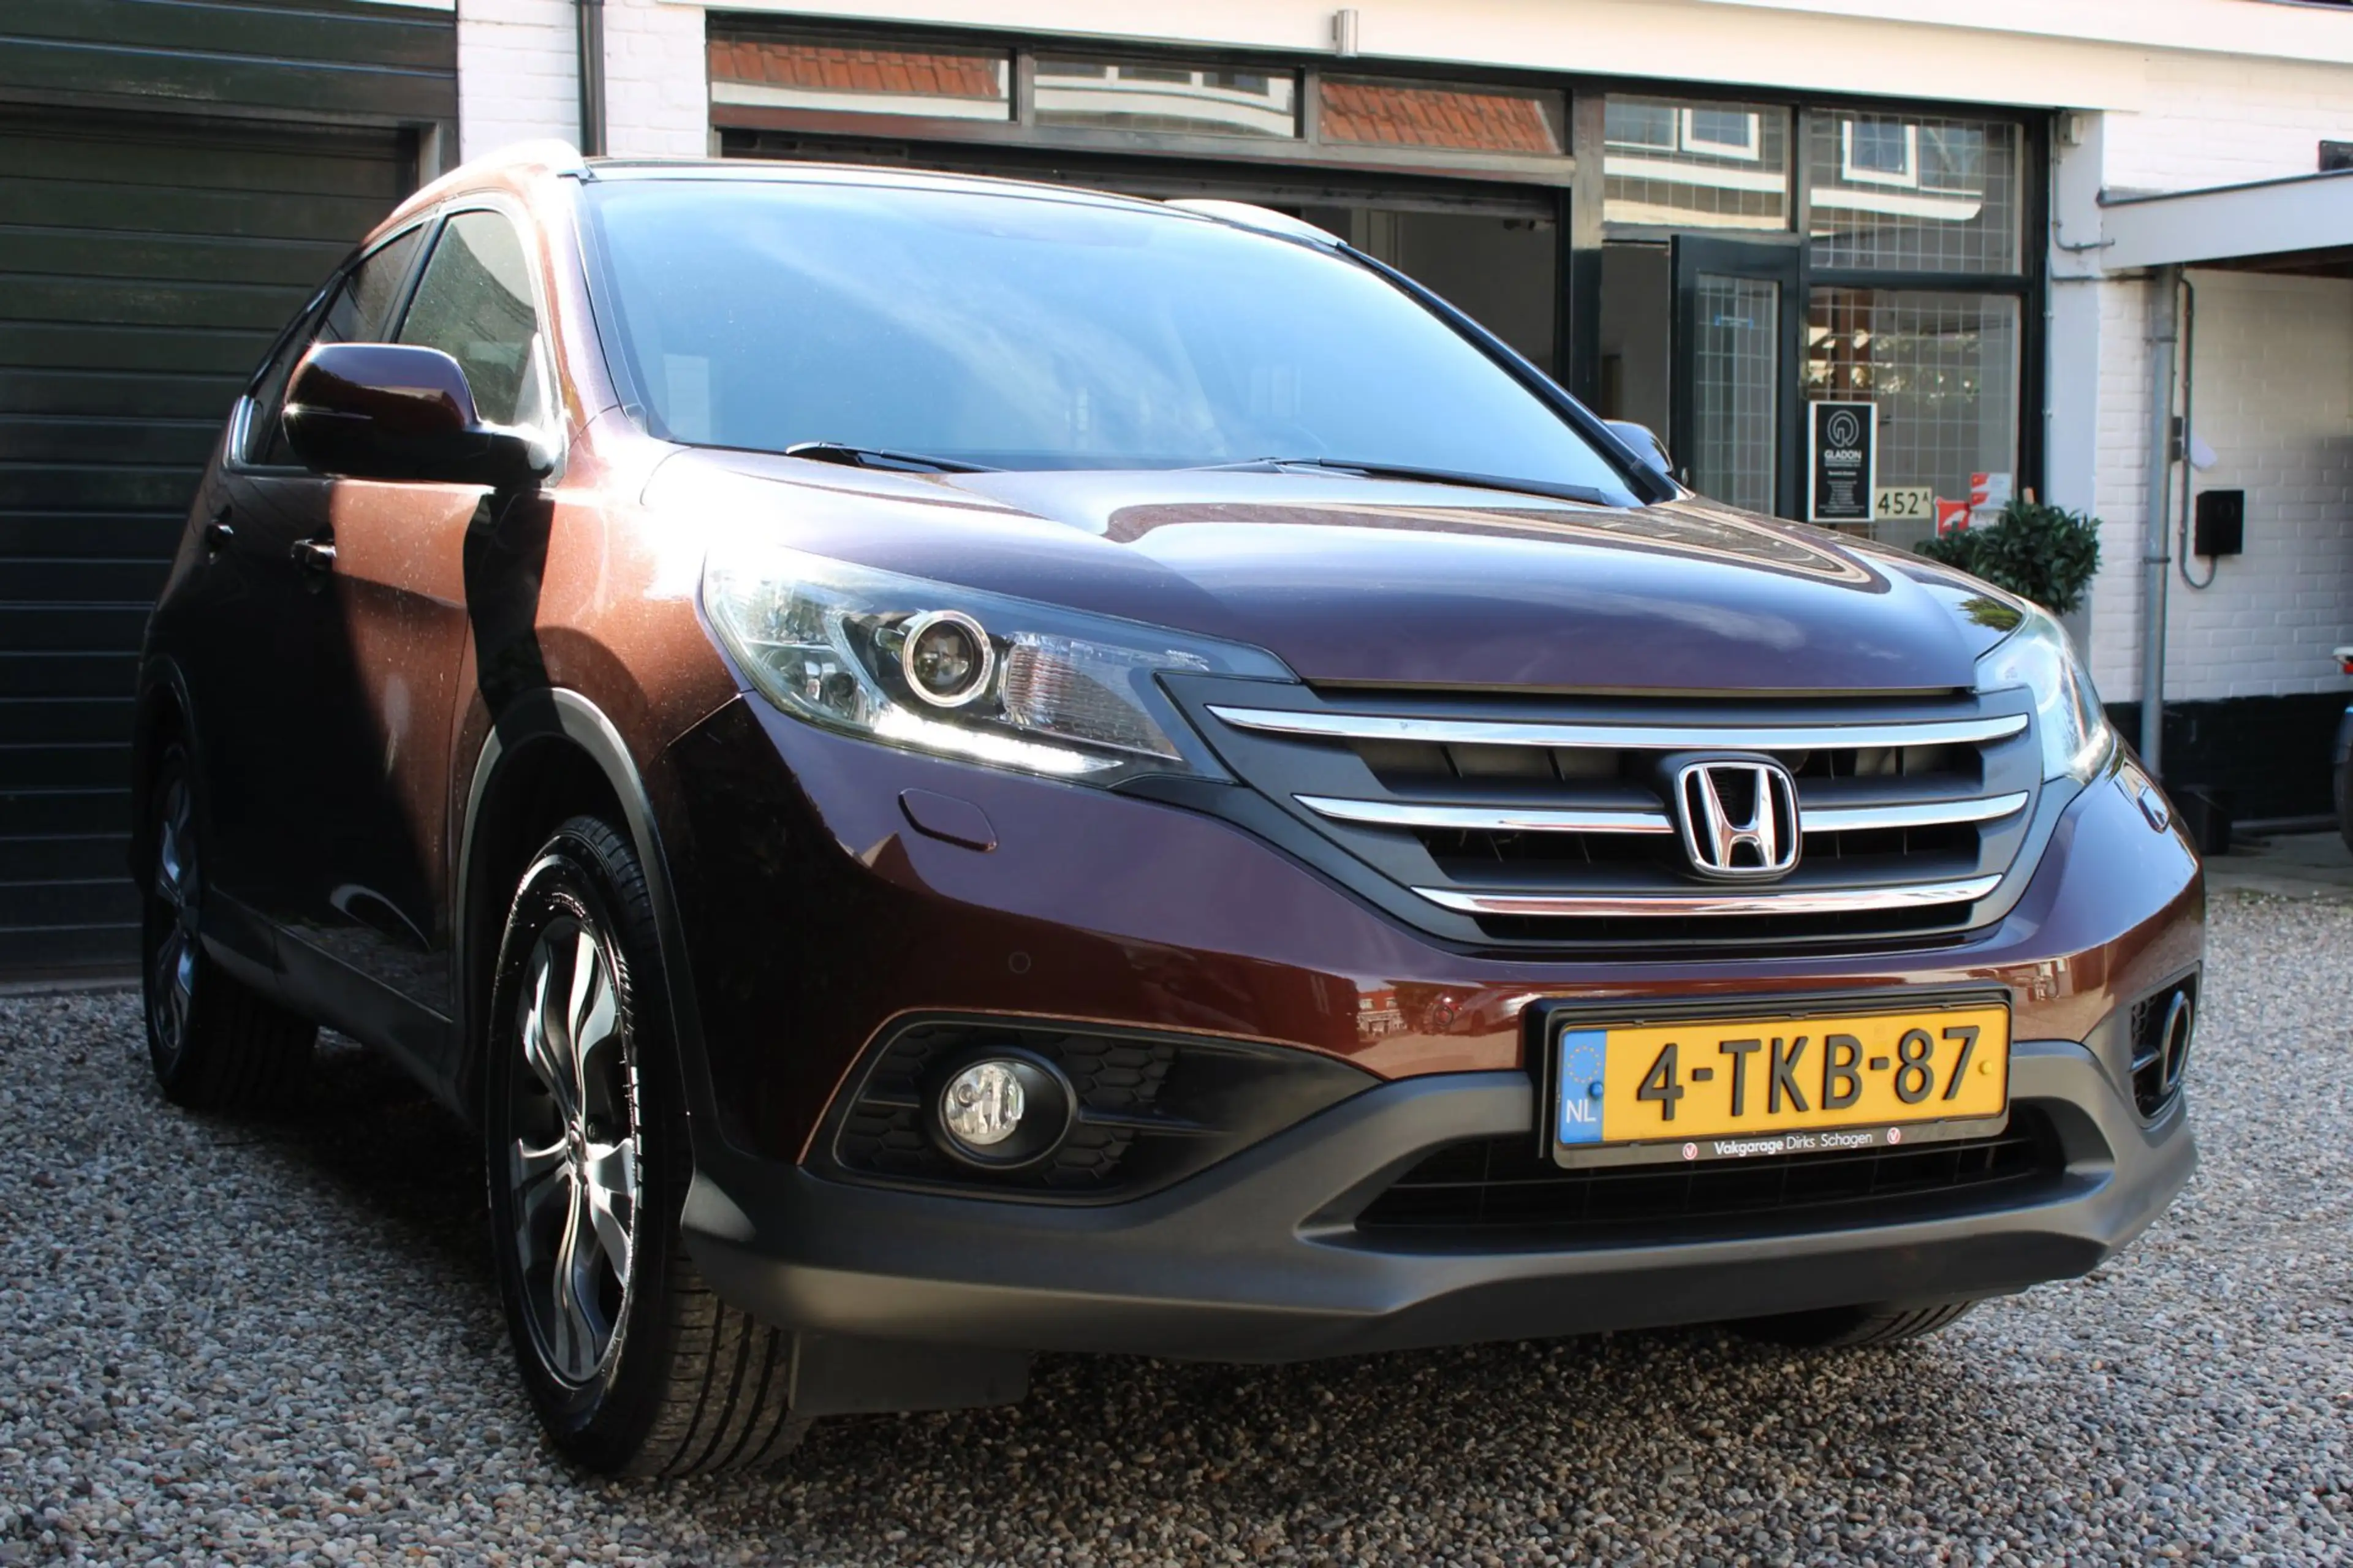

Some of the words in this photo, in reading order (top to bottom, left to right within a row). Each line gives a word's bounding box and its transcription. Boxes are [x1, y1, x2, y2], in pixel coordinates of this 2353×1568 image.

[1636, 1025, 1980, 1121] 4-TKB-87
[1566, 1099, 1597, 1124] NL
[1714, 1141, 1784, 1157] Vakgarage
[1786, 1135, 1816, 1149] Dirks
[1821, 1132, 1873, 1148] Schagen
